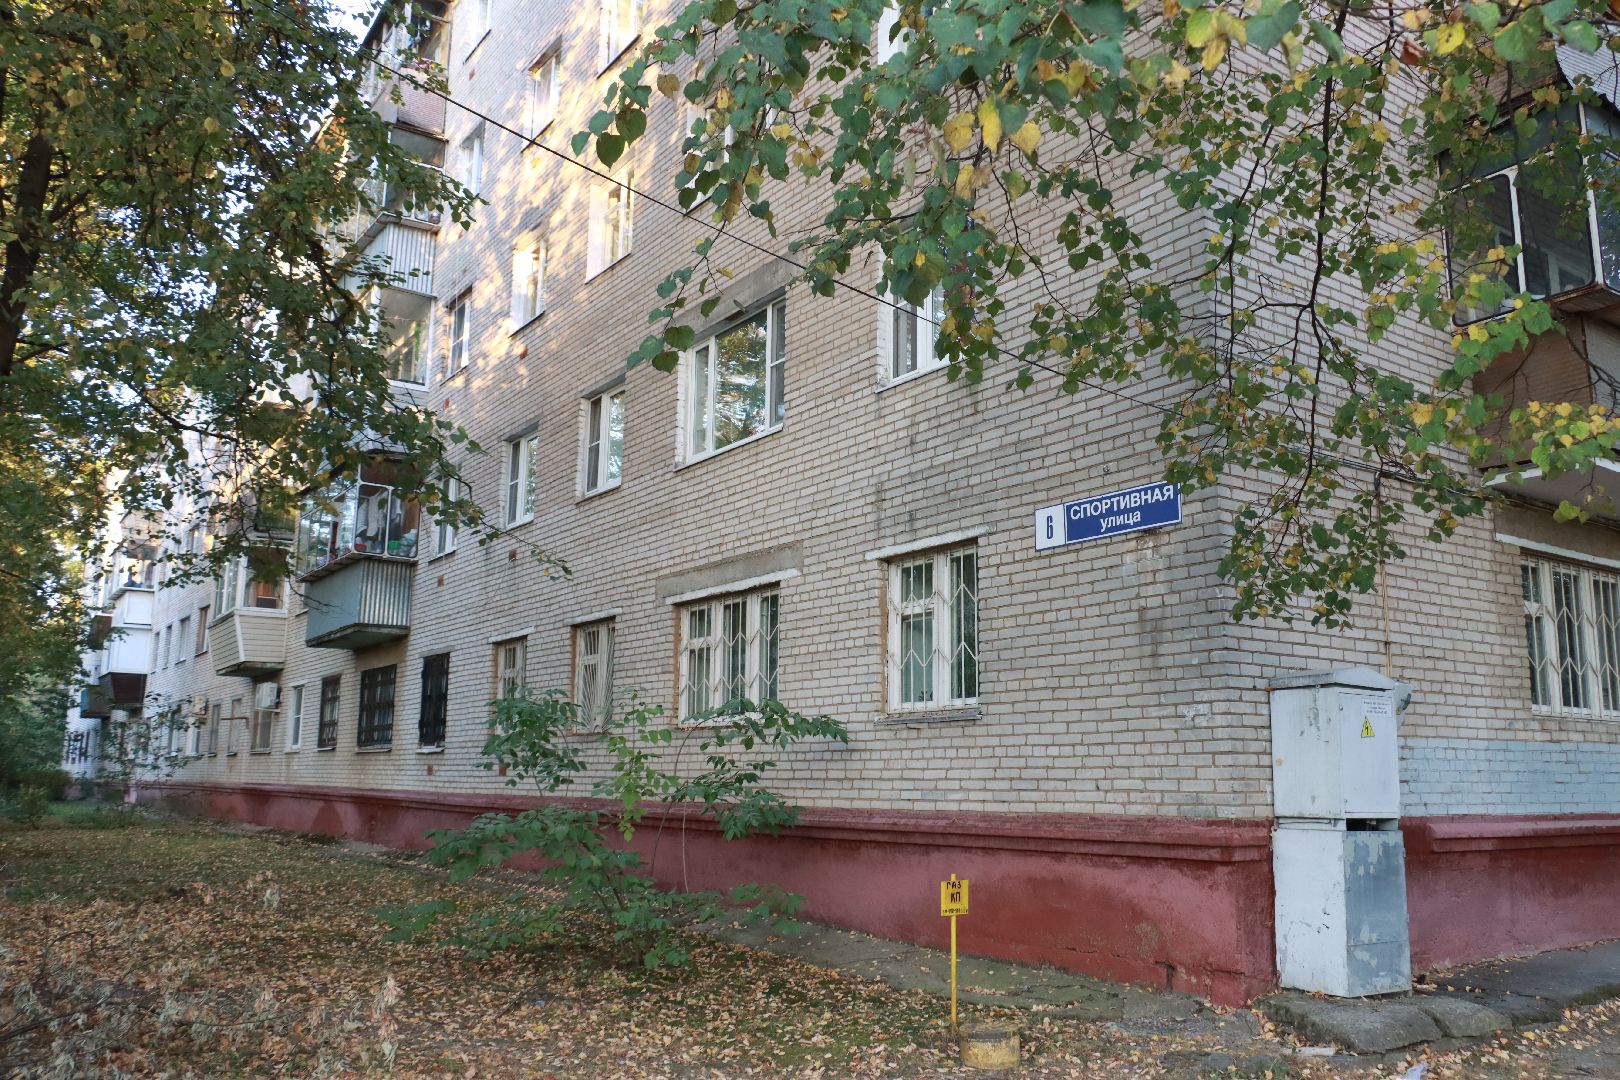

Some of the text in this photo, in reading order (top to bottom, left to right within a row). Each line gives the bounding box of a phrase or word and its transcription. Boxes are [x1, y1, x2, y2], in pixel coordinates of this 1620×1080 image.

[1070, 485, 1174, 520] СПОРТИВНАЯ
[1046, 515, 1054, 540] 6
[1100, 510, 1141, 532] улица
[946, 881, 962, 890] ГАЗ
